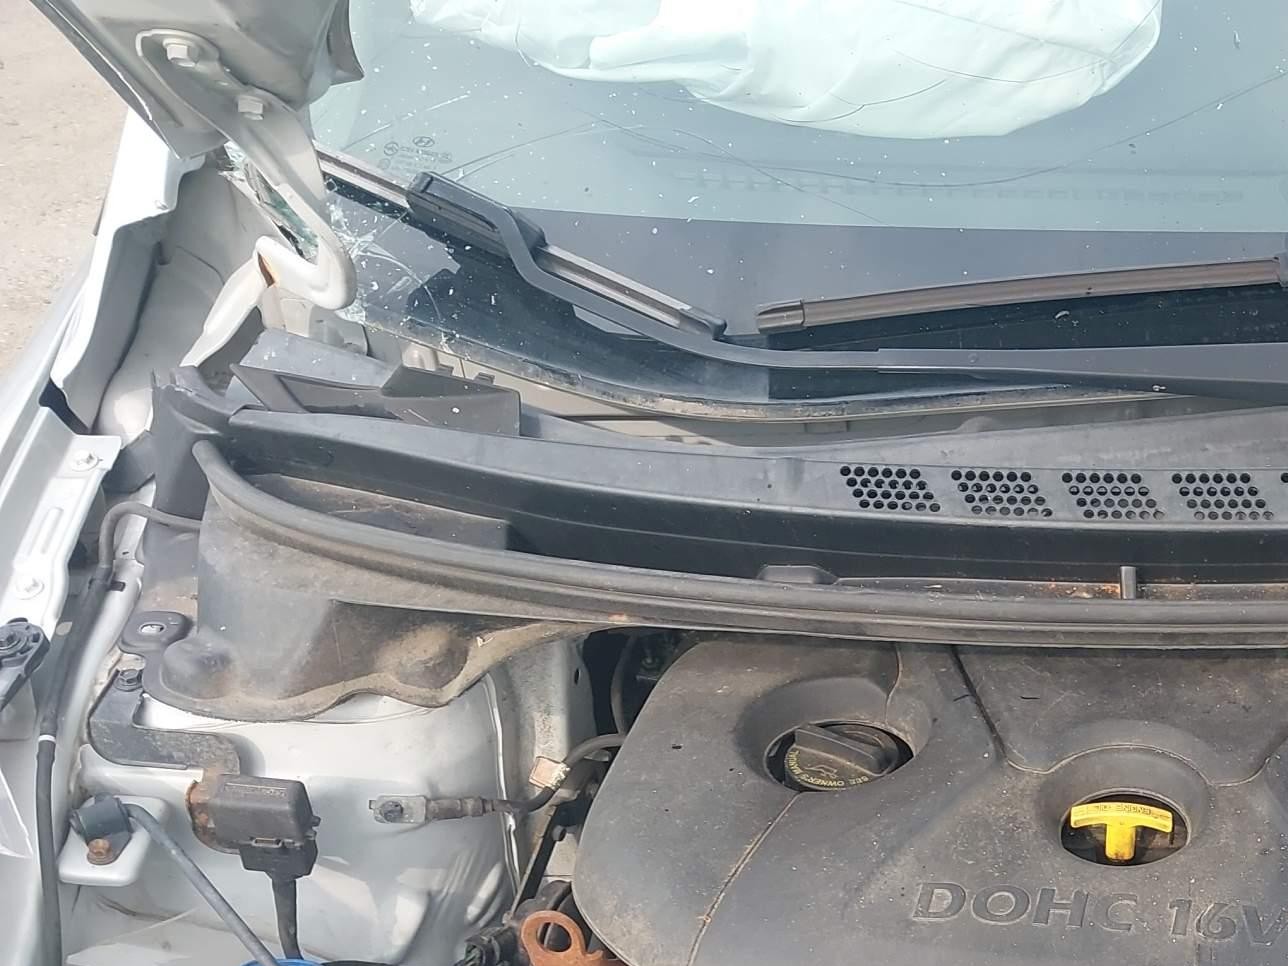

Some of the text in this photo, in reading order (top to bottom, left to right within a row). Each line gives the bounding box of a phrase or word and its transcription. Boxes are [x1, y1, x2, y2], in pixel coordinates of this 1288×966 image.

[800, 774, 845, 787] OWNER'S
[848, 775, 870, 785] SEE
[911, 881, 1138, 933] DOHC
